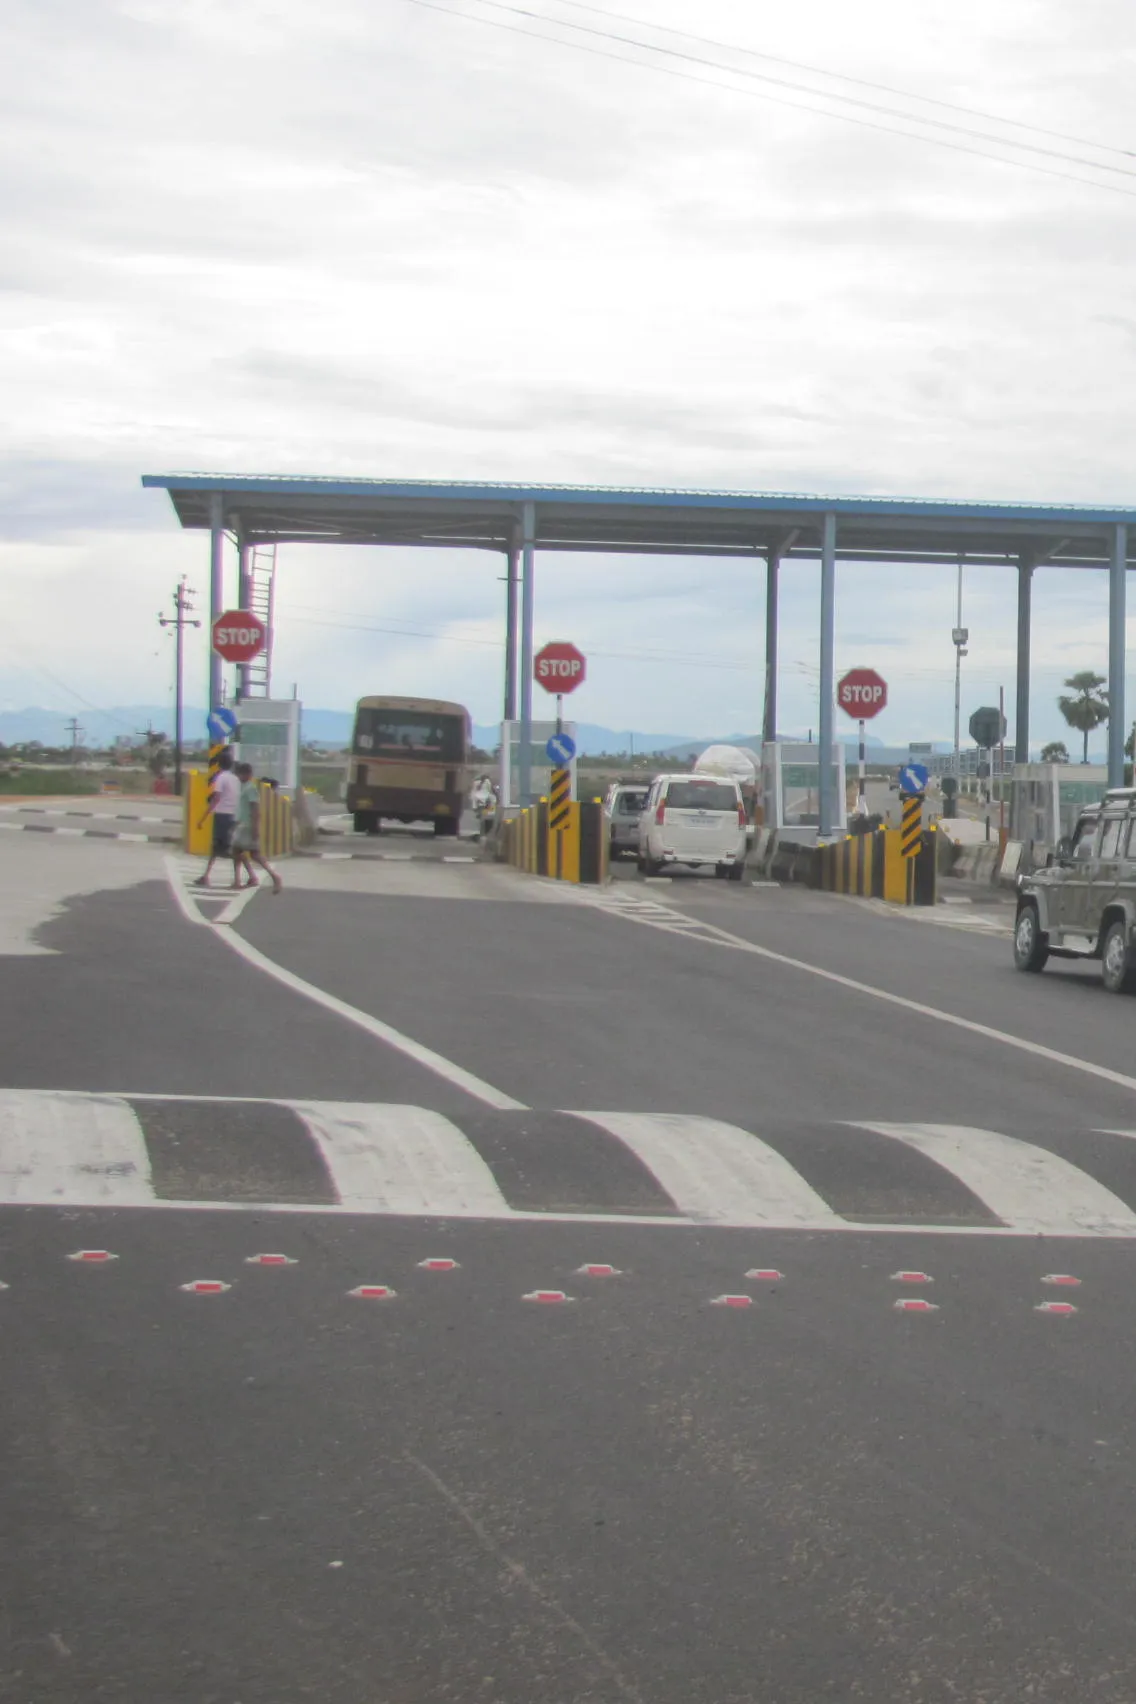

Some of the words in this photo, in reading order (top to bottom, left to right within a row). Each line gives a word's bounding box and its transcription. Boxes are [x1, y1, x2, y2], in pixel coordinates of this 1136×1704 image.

[217, 628, 260, 645] STOP
[539, 660, 581, 677] STOP
[842, 685, 882, 703] STOP
